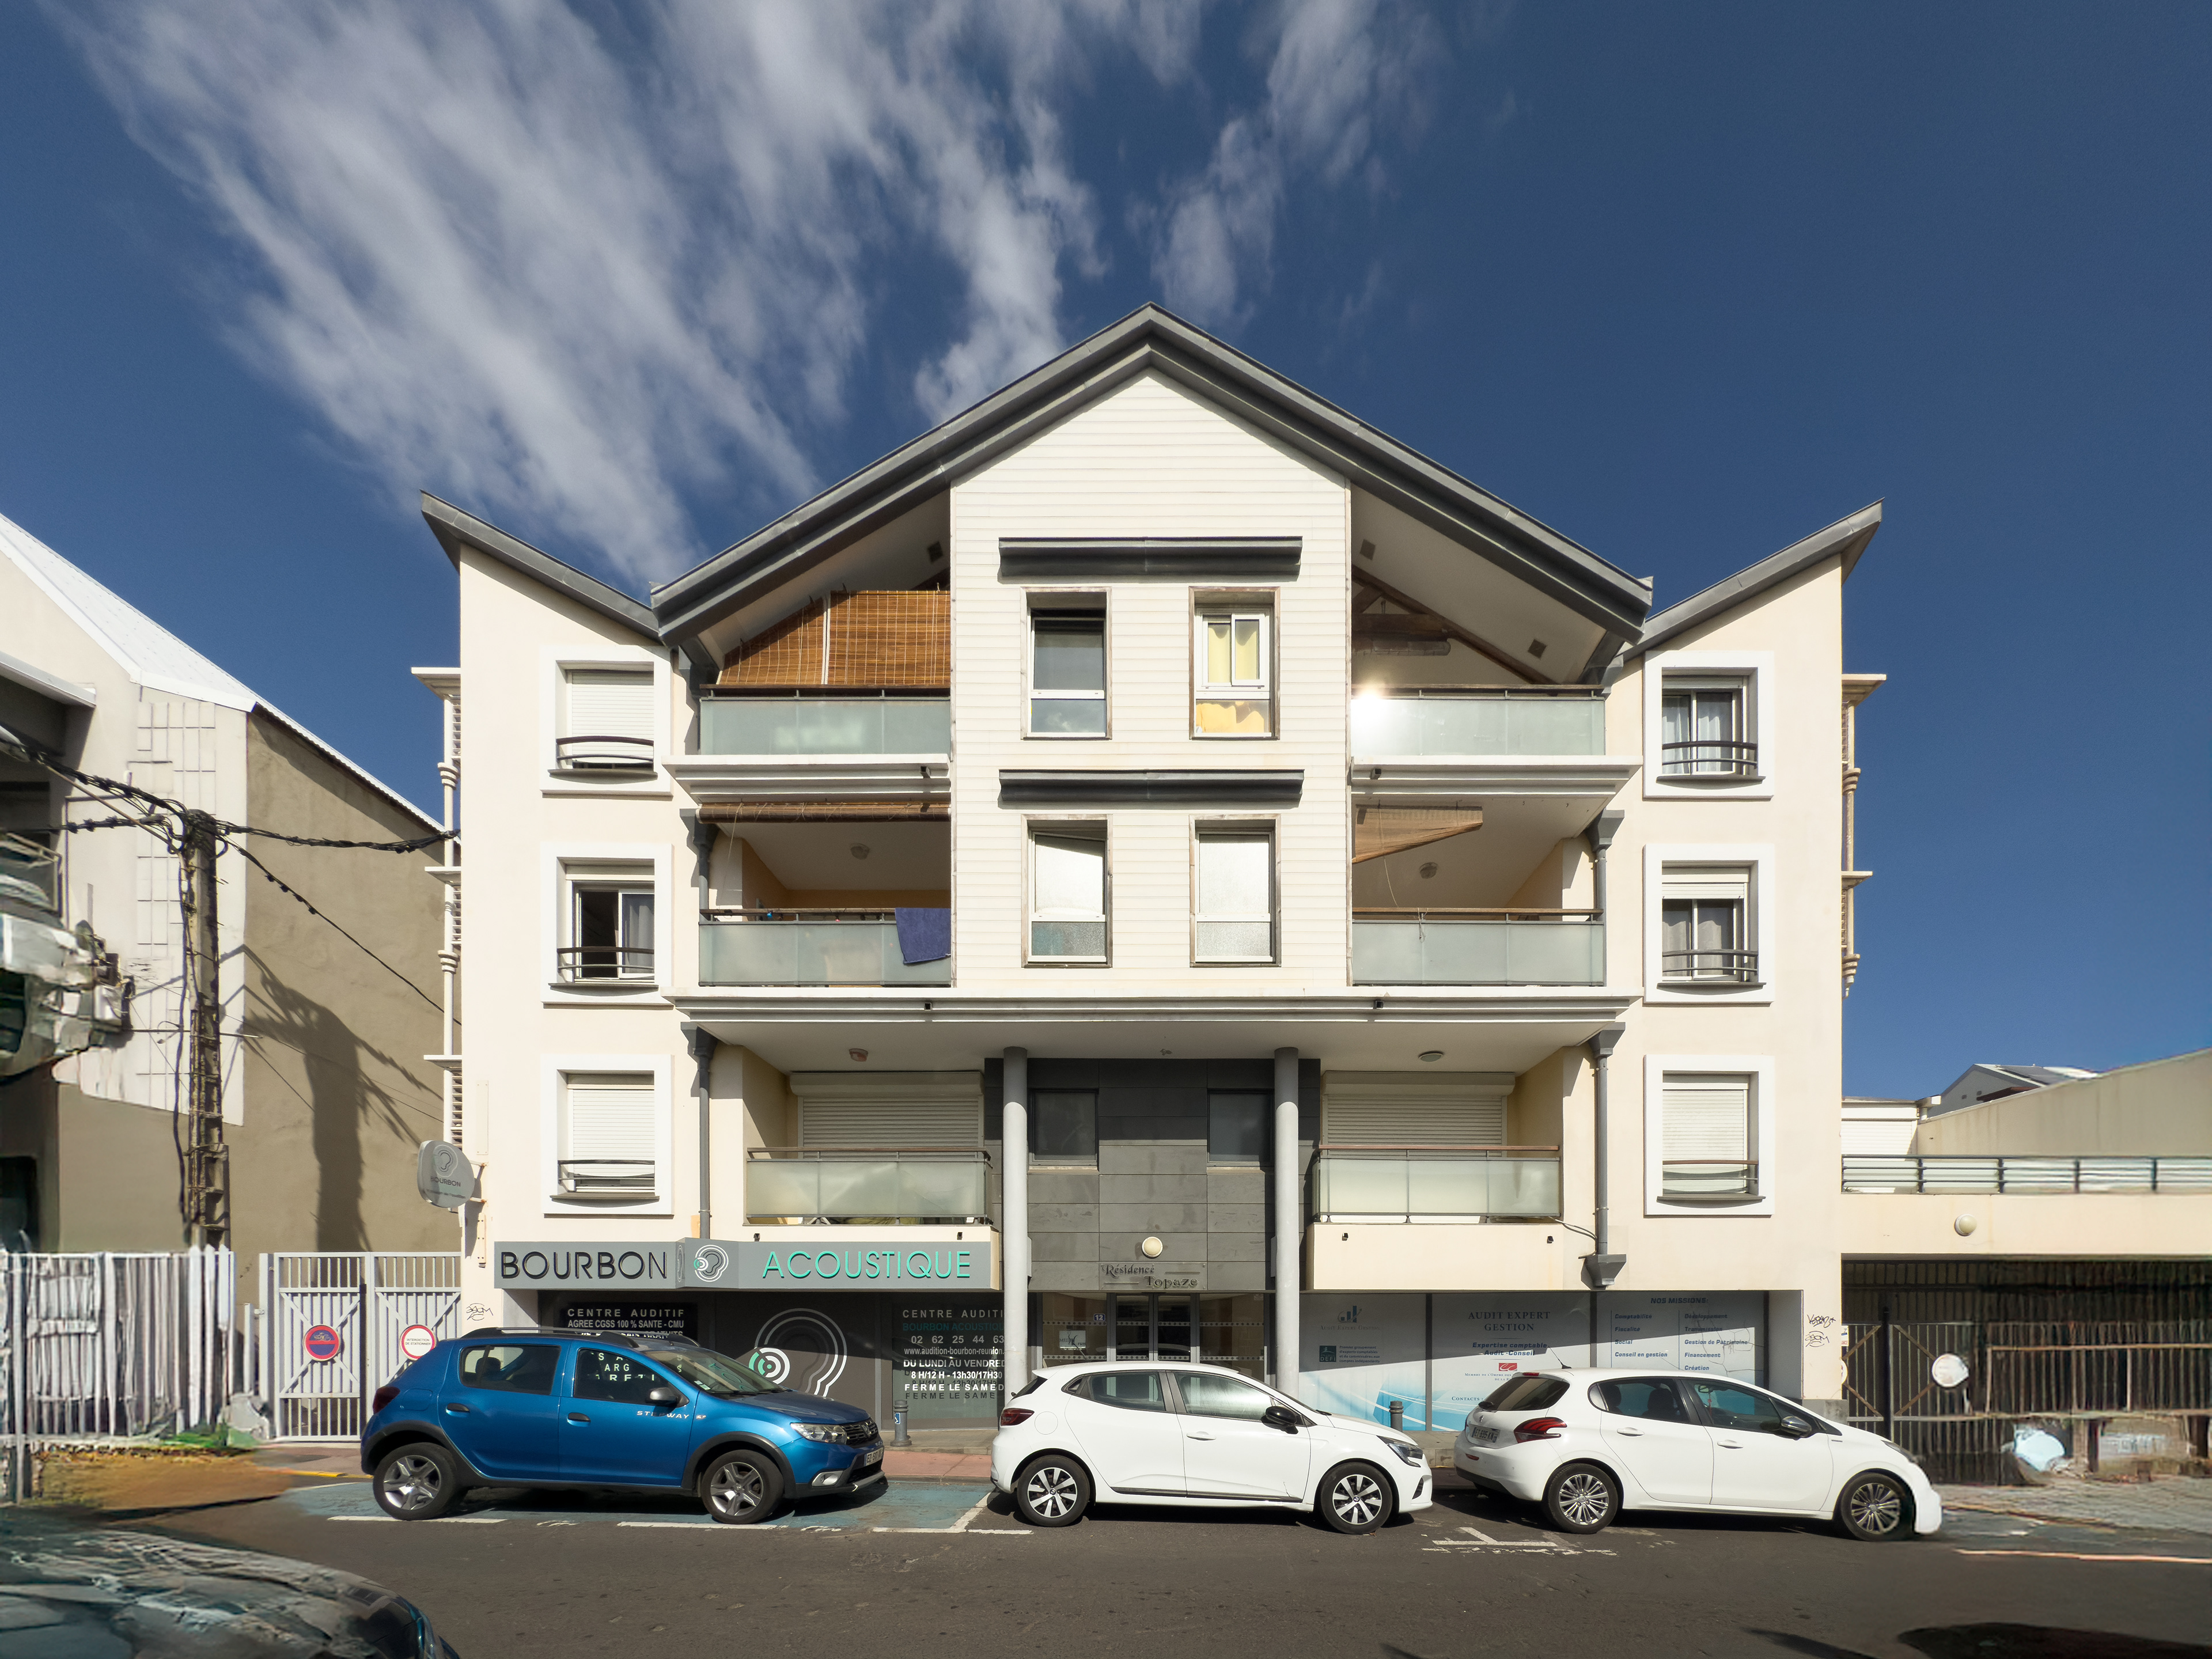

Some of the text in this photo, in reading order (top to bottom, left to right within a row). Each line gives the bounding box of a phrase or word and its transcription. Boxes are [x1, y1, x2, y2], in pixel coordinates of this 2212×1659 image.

[430, 1176, 461, 1187] BOURBON
[501, 1251, 970, 1279] BOURBON ACOUSTIQUE
[1102, 1264, 1154, 1279] Résidence
[1144, 1276, 1198, 1289] Topaze
[567, 1309, 684, 1317] CENTRE AUDITIF
[903, 1309, 952, 1318] CENTRE
[568, 1320, 593, 1328] AGREE
[595, 1320, 615, 1328] CGSS
[617, 1320, 629, 1328] 100
[630, 1320, 637, 1328] %
[638, 1320, 662, 1328] SANTE
[668, 1320, 684, 1328] CMU
[903, 1323, 949, 1331] BOURBON
[911, 1335, 1004, 1344] 02 62 25 44 63
[903, 1359, 916, 1368] DU
[919, 1359, 946, 1368] LUNDI
[948, 1359, 961, 1368] AU
[911, 1371, 916, 1379] 8
[918, 1371, 937, 1379] H/12
[938, 1371, 945, 1379] H
[952, 1371, 1002, 1379] 13h30/17H30
[637, 1410, 689, 1419] STEPWAY
